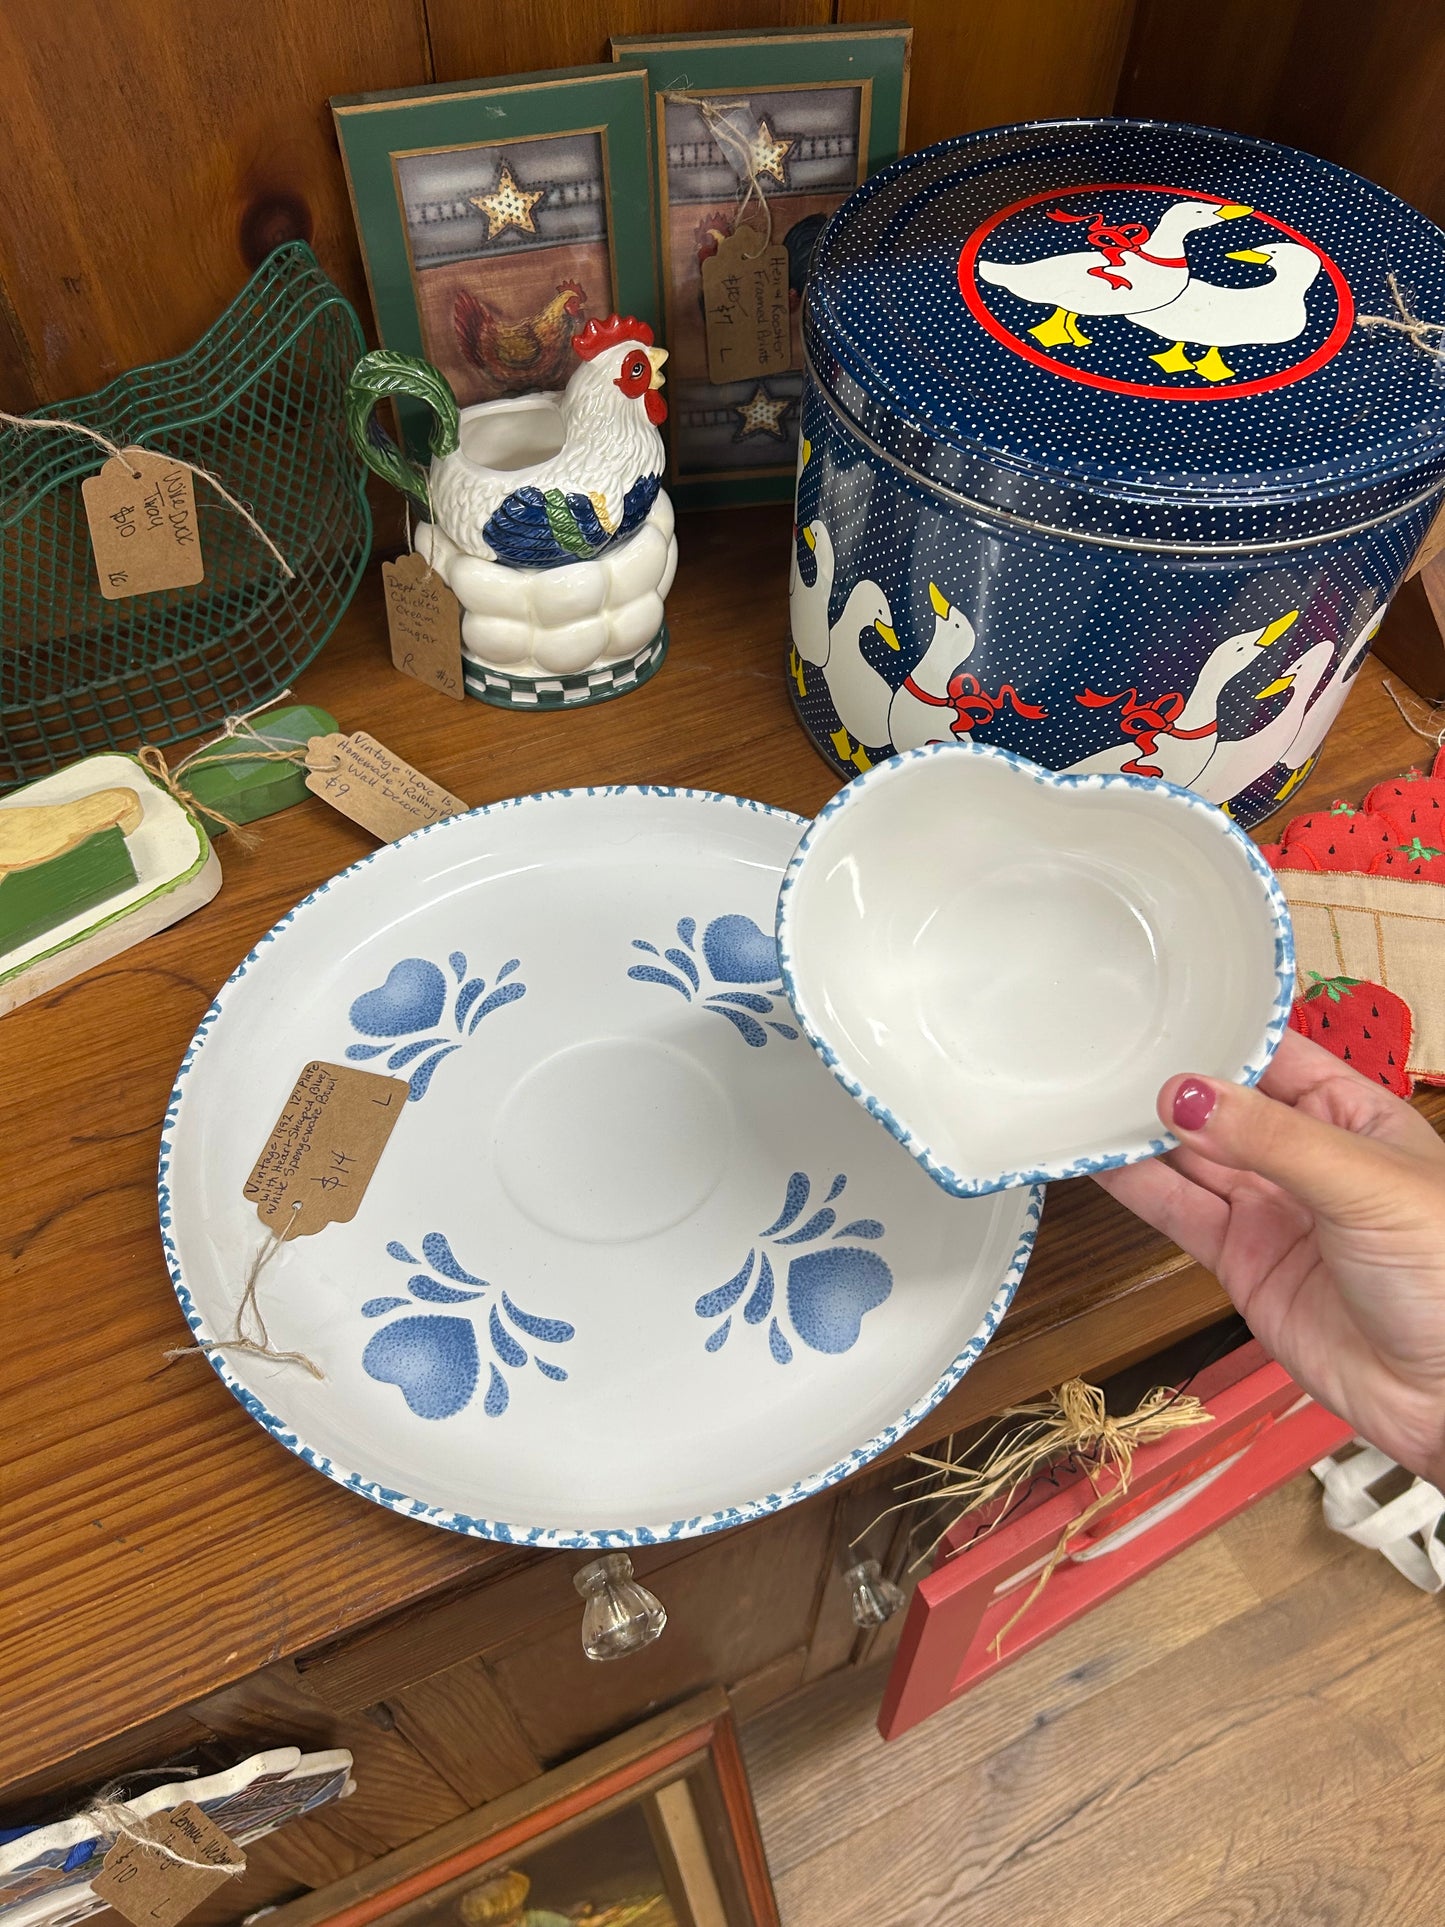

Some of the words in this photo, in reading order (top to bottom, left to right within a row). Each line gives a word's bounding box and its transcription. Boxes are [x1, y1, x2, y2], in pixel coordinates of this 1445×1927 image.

[770, 257, 785, 286] Hen
[754, 270, 770, 324] Framed
[771, 304, 787, 360] Rooster
[144, 481, 165, 531] Tray
[163, 470, 187, 509] Wire
[110, 505, 136, 538] $10
[169, 510, 194, 546] Duck
[390, 591, 440, 614] Chicken
[398, 622, 438, 644] Sugar
[354, 734, 401, 773] Vintage
[325, 774, 350, 798] $9
[348, 763, 379, 787] Wall
[372, 1093, 393, 1107] L
[246, 1141, 281, 1194] Vintage
[273, 1114, 294, 1139] 1992
[297, 1063, 320, 1089] Plate
[283, 1107, 322, 1177] Spongeware
[316, 1078, 339, 1105] Bowl
[310, 1150, 357, 1192] $14
[108, 1848, 138, 1883] $10
